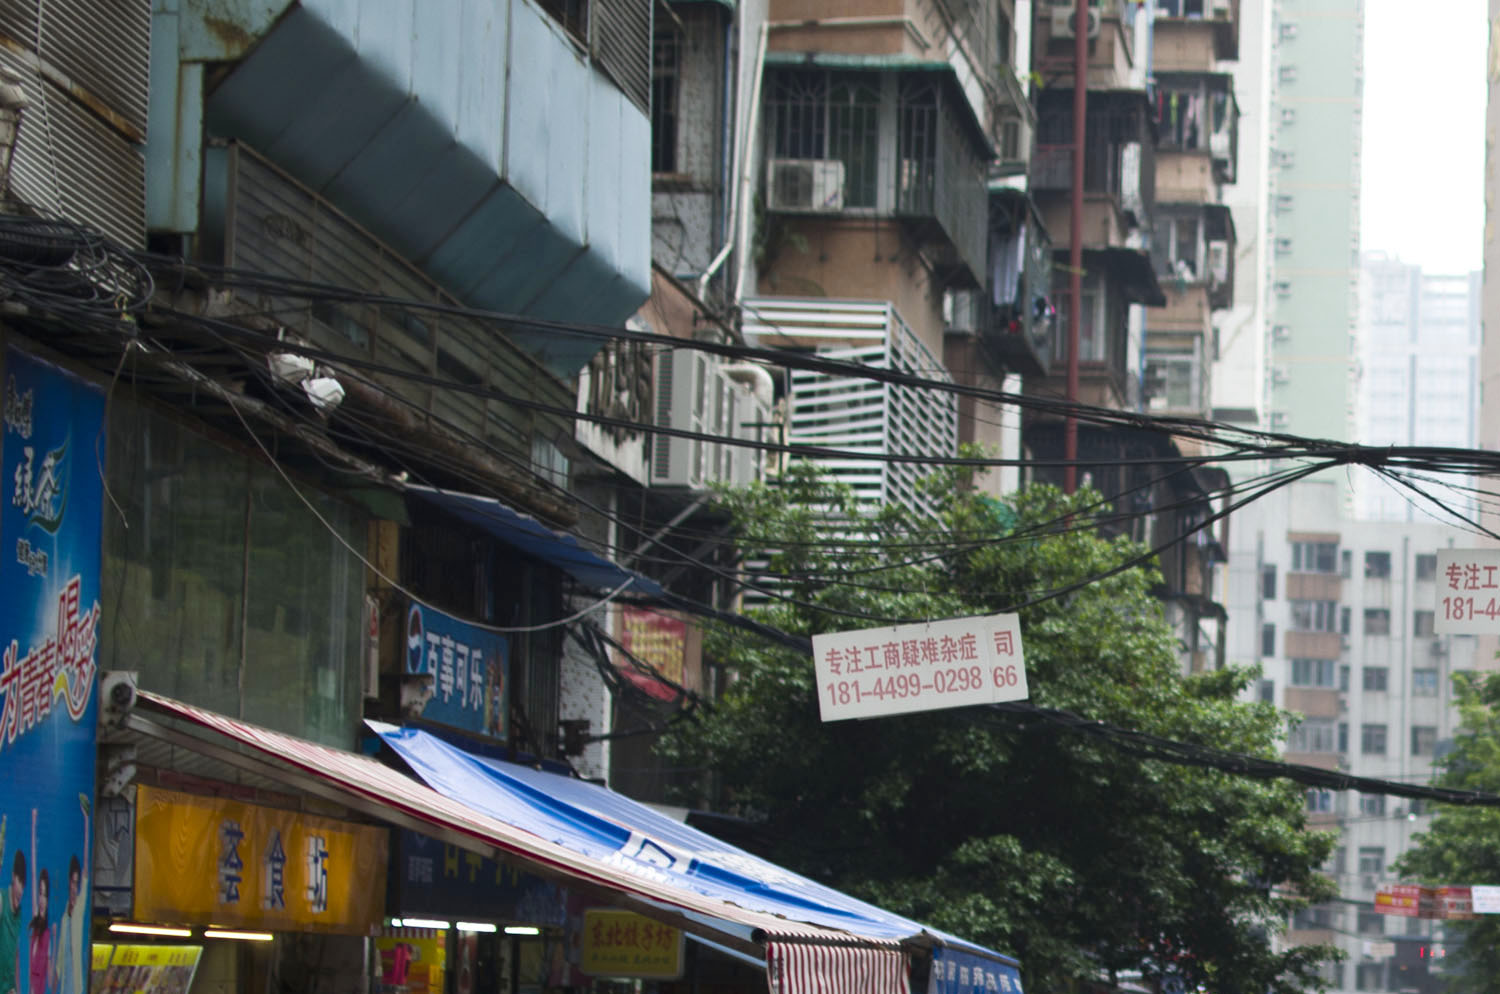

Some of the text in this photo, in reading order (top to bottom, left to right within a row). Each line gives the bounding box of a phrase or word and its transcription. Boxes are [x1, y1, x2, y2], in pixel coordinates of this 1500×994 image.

[0, 574, 101, 750] 为青春喝彩
[425, 631, 483, 712] 百事可乐
[825, 630, 1014, 676] 专注工商疑难杂症 司
[826, 666, 983, 706] 181-4499-0298
